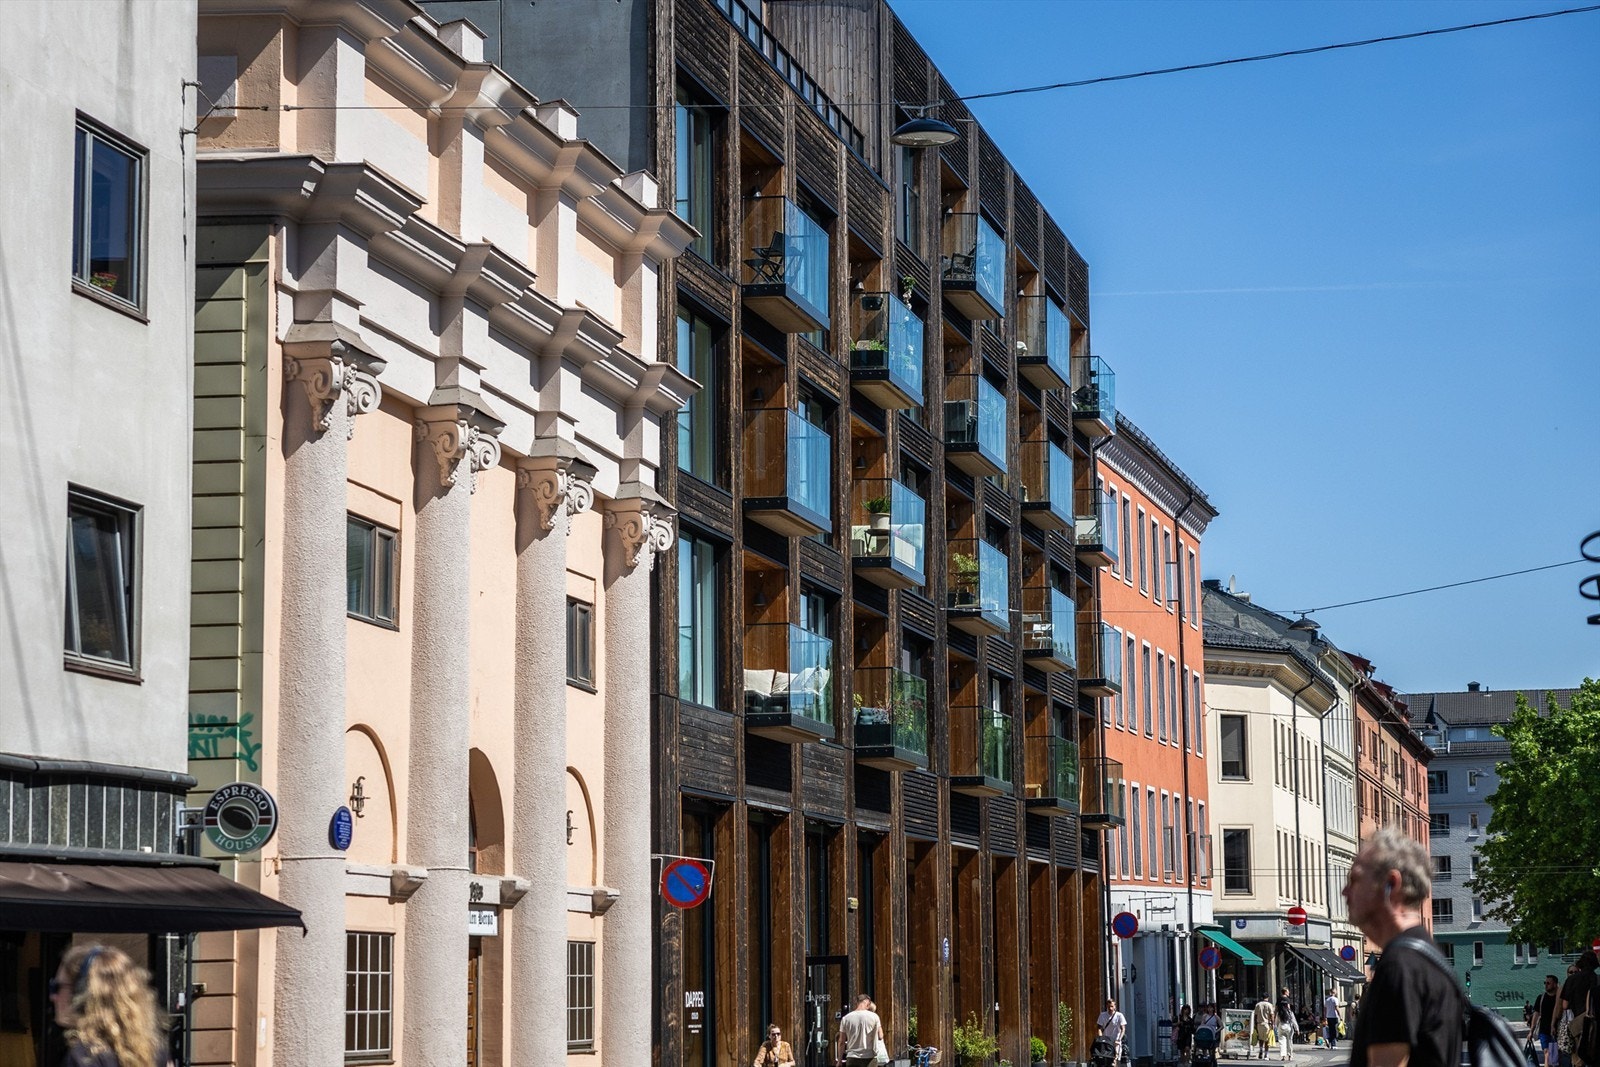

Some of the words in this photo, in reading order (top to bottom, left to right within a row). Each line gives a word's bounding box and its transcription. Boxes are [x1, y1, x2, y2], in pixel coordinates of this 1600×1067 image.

[210, 785, 269, 811] ESPRESSO
[214, 833, 262, 851] HOUSE
[685, 991, 704, 1008] DAPPER
[805, 994, 832, 1003] DAPPER
[1494, 990, 1524, 1003] SHIN
